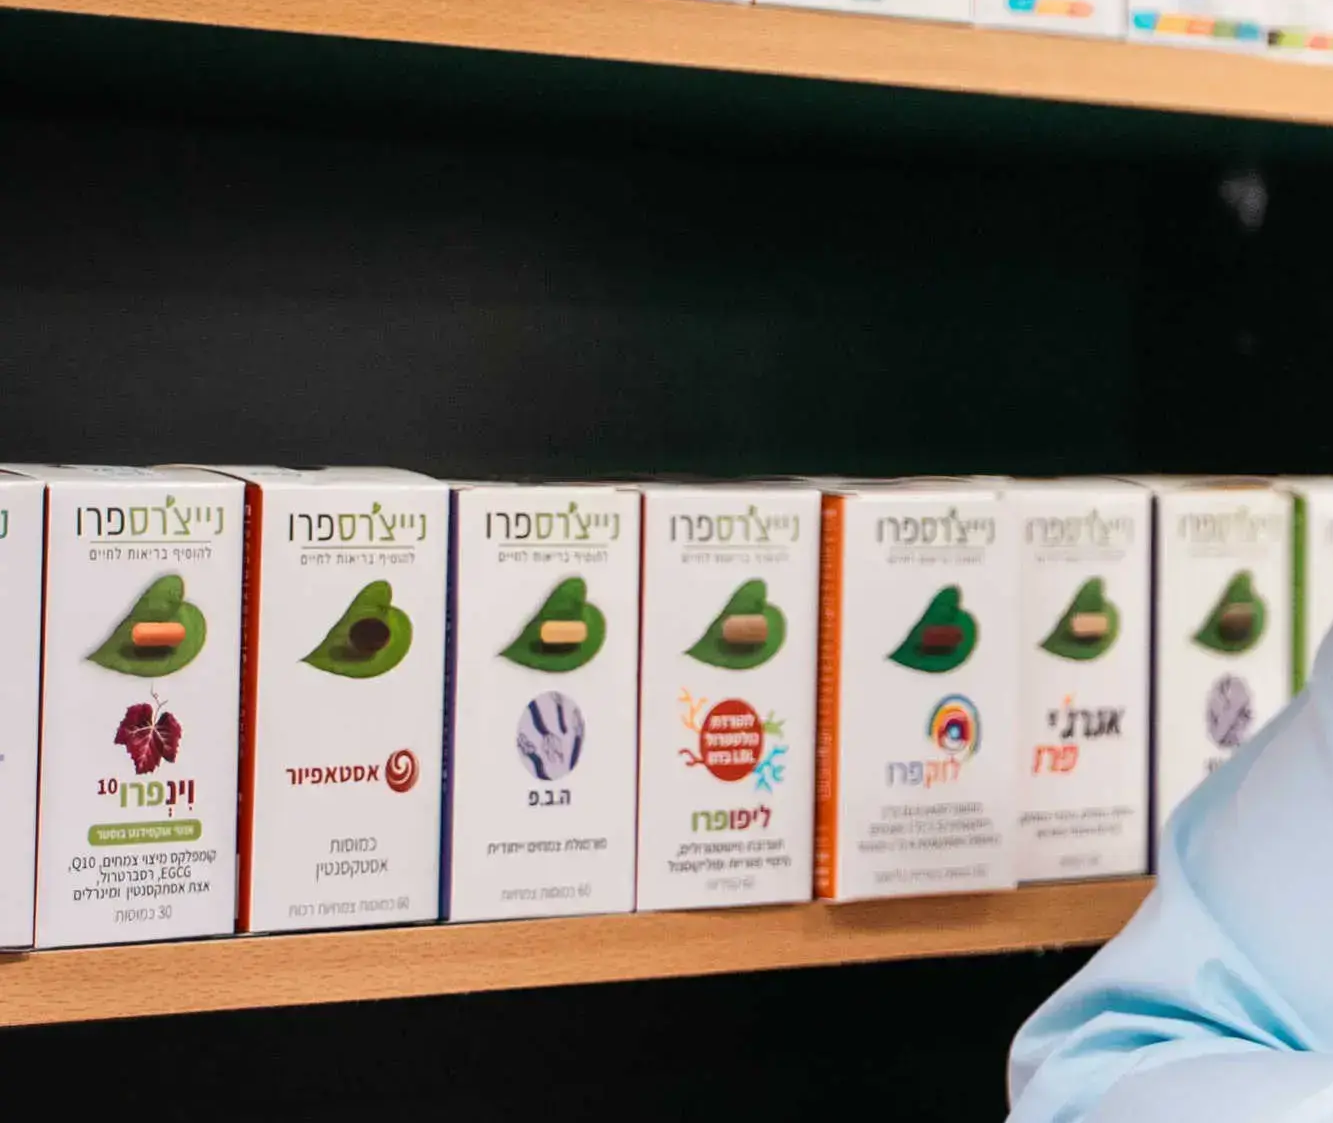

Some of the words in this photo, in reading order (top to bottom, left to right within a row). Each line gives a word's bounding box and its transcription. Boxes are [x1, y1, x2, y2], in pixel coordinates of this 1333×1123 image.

[89, 547, 122, 561] לחיים
[127, 548, 169, 560] בריאות
[173, 547, 212, 562] להוסיף
[300, 552, 332, 566] לחיים
[335, 553, 375, 565] בריאות
[285, 764, 380, 785] אסטאפיור
[329, 836, 378, 854] כמוסות
[141, 853, 168, 865] מיצוי
[170, 849, 217, 866] קומפלקס
[315, 858, 389, 884] אסטקסנטין
[73, 886, 121, 901] ומינרלים
[115, 908, 156, 923] כמוסות
[157, 904, 173, 920] 30
